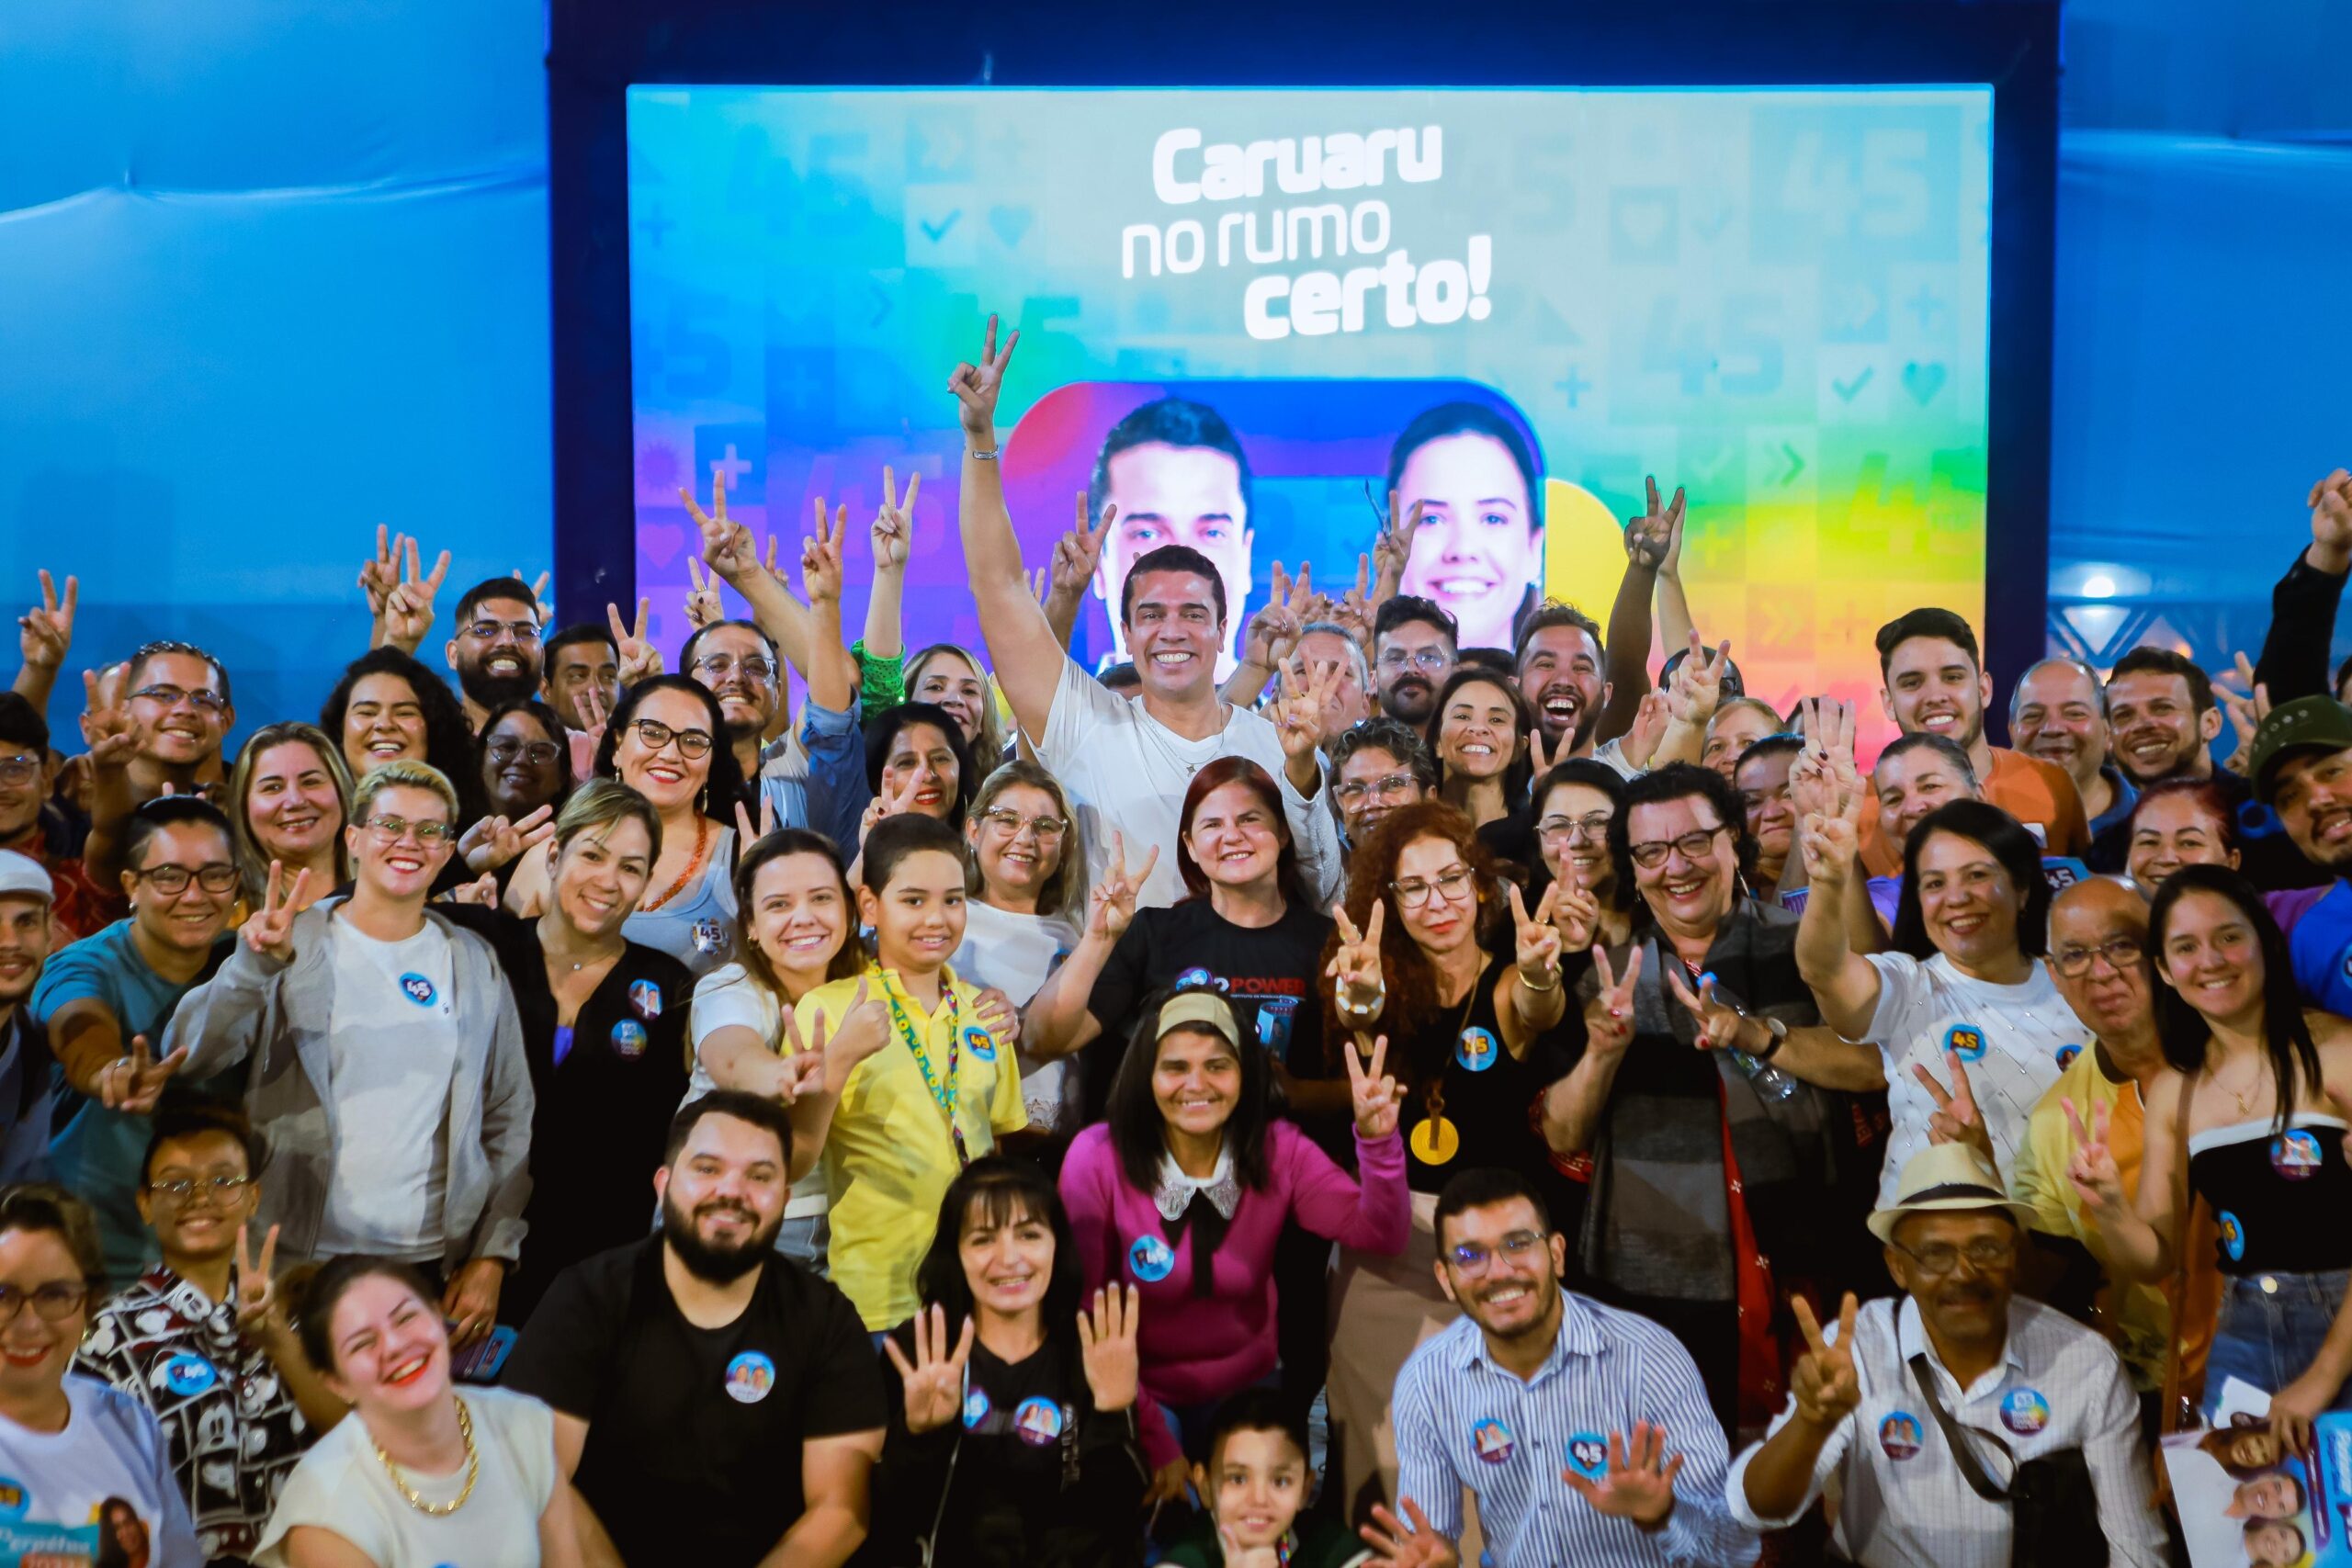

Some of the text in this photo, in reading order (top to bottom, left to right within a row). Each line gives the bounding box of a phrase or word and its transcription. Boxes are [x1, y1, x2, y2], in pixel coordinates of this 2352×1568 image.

[1152, 125, 1442, 205] Caruaru
[1122, 200, 1391, 279] no rumo
[1243, 234, 1492, 340] certo!
[700, 927, 722, 941] 45
[406, 978, 432, 998] 45
[1231, 977, 1306, 995] POWER
[970, 1033, 990, 1050] 45
[1952, 1032, 1978, 1049] 45
[1576, 1442, 1602, 1463] 45
